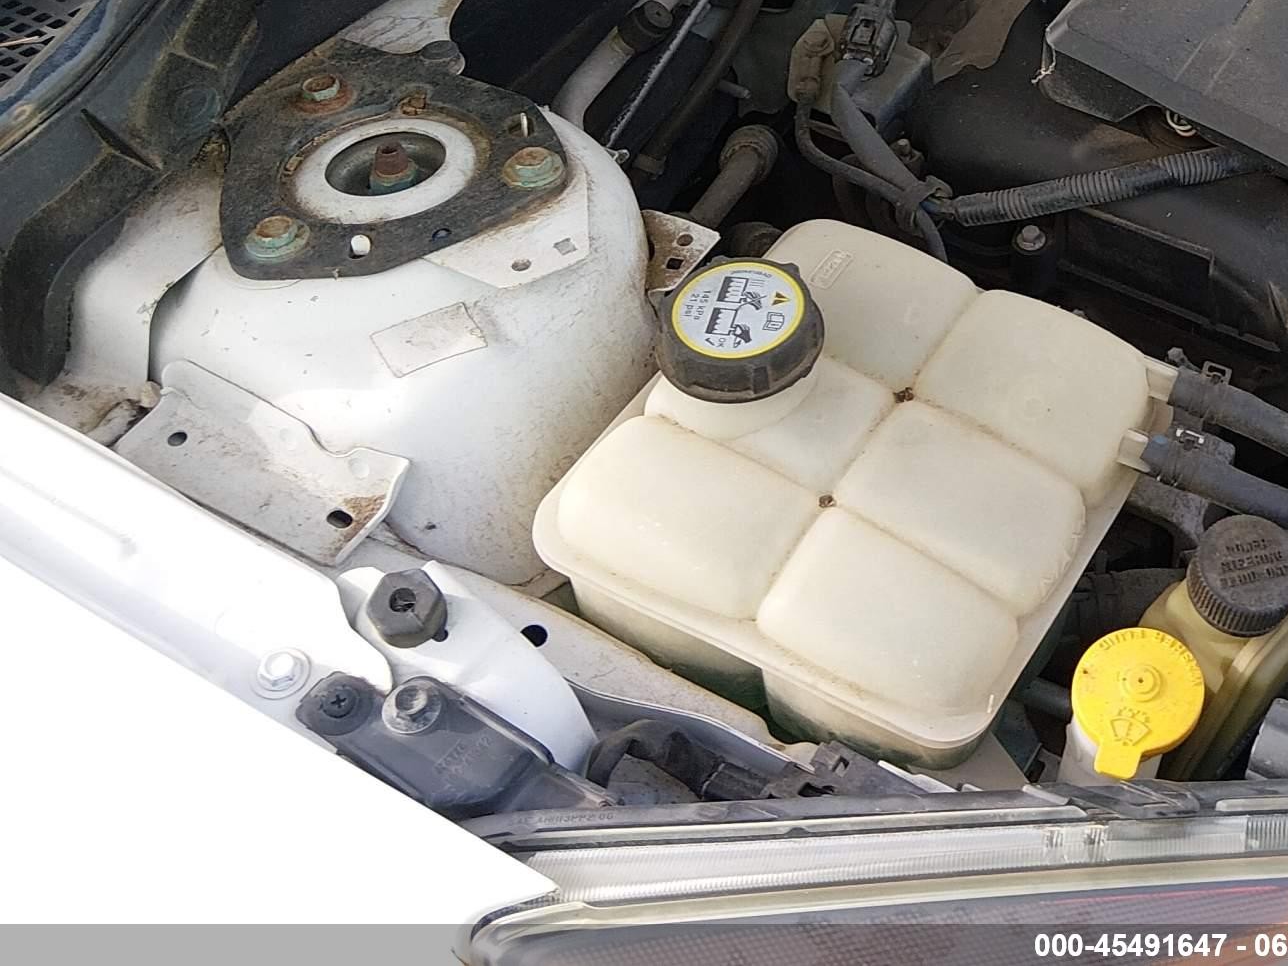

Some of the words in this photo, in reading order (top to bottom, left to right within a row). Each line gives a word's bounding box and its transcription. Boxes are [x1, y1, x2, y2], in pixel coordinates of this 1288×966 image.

[690, 293, 700, 302] 21
[701, 290, 711, 304] 145
[684, 304, 694, 317] psi
[693, 305, 704, 320] kPa
